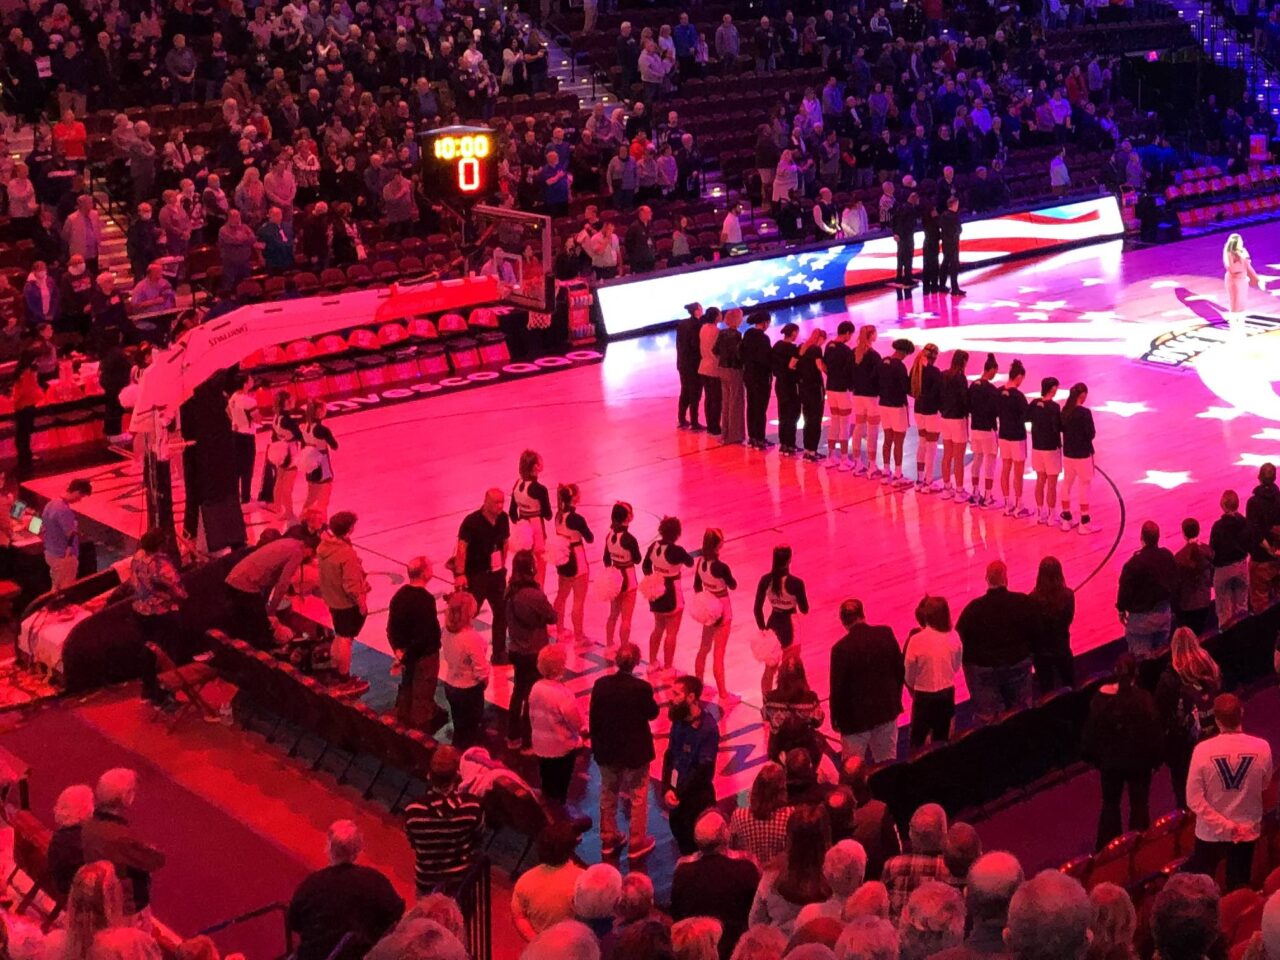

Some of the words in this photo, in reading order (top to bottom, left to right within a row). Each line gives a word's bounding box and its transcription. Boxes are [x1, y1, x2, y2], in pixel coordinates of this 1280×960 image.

[433, 134, 489, 160] 10:00
[457, 157, 480, 192] 0
[1210, 753, 1258, 792] V
